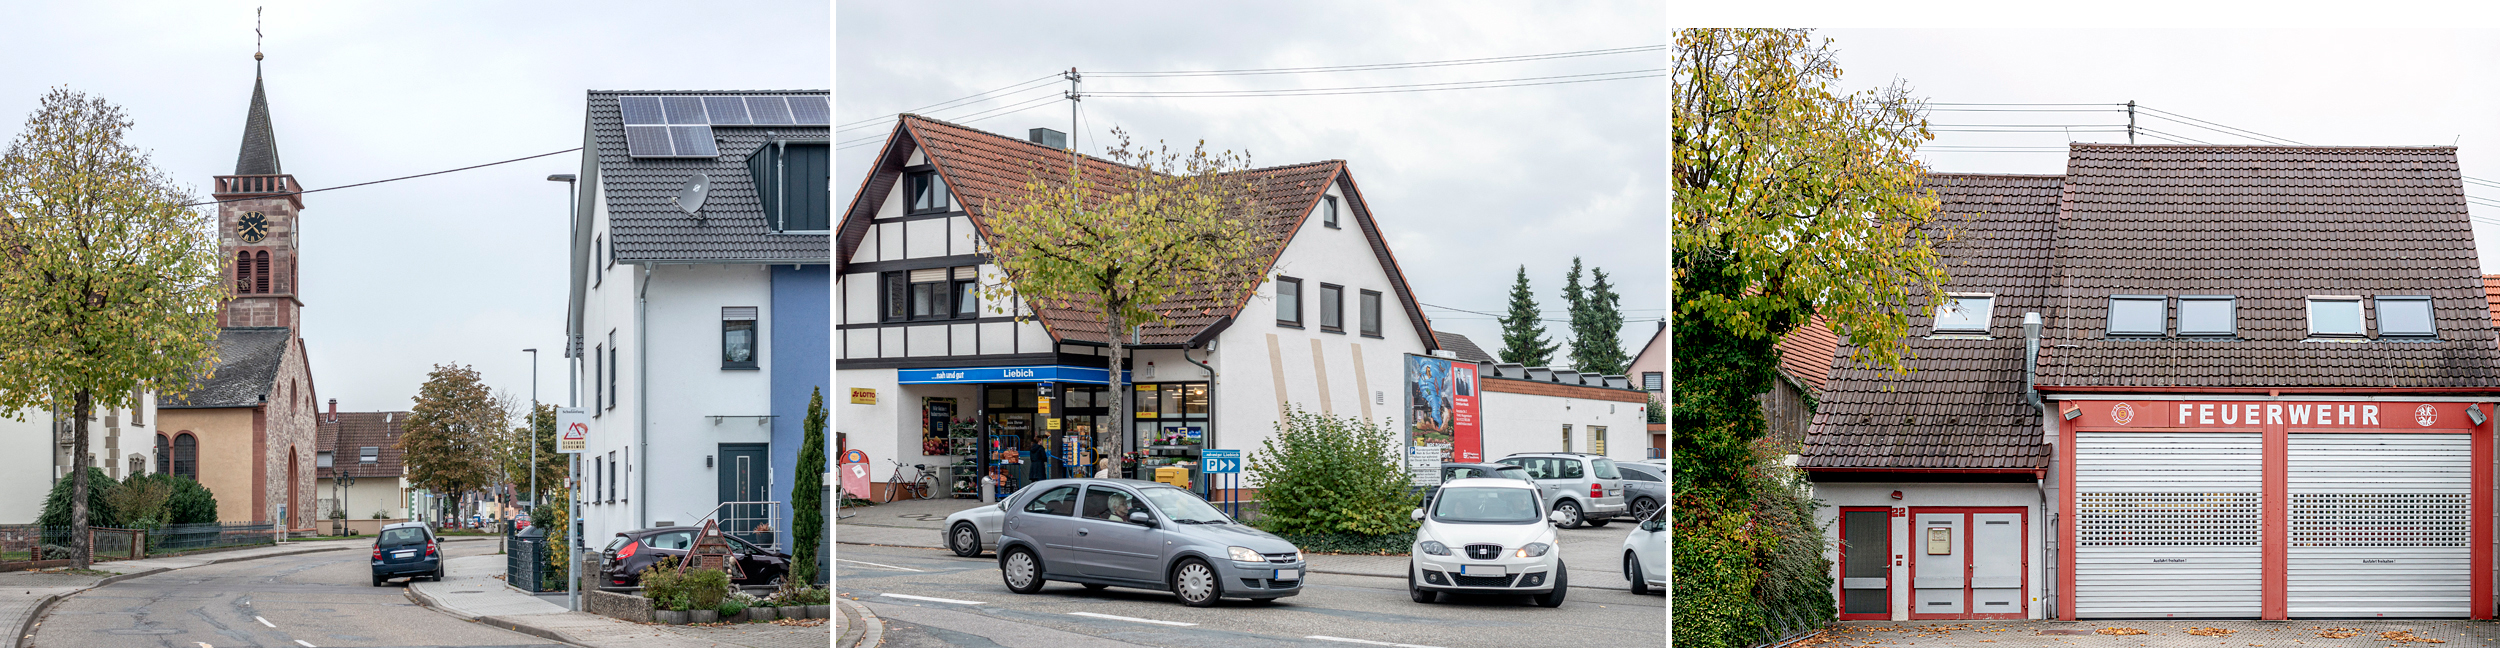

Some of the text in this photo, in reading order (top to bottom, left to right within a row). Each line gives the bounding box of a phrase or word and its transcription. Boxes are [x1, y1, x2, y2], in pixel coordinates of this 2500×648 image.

[956, 371, 964, 380] gut
[1003, 369, 1034, 378] Liebich
[2179, 403, 2379, 425] FEUERWEHR
[1209, 461, 1216, 470] P
[1892, 507, 1906, 518] 22
